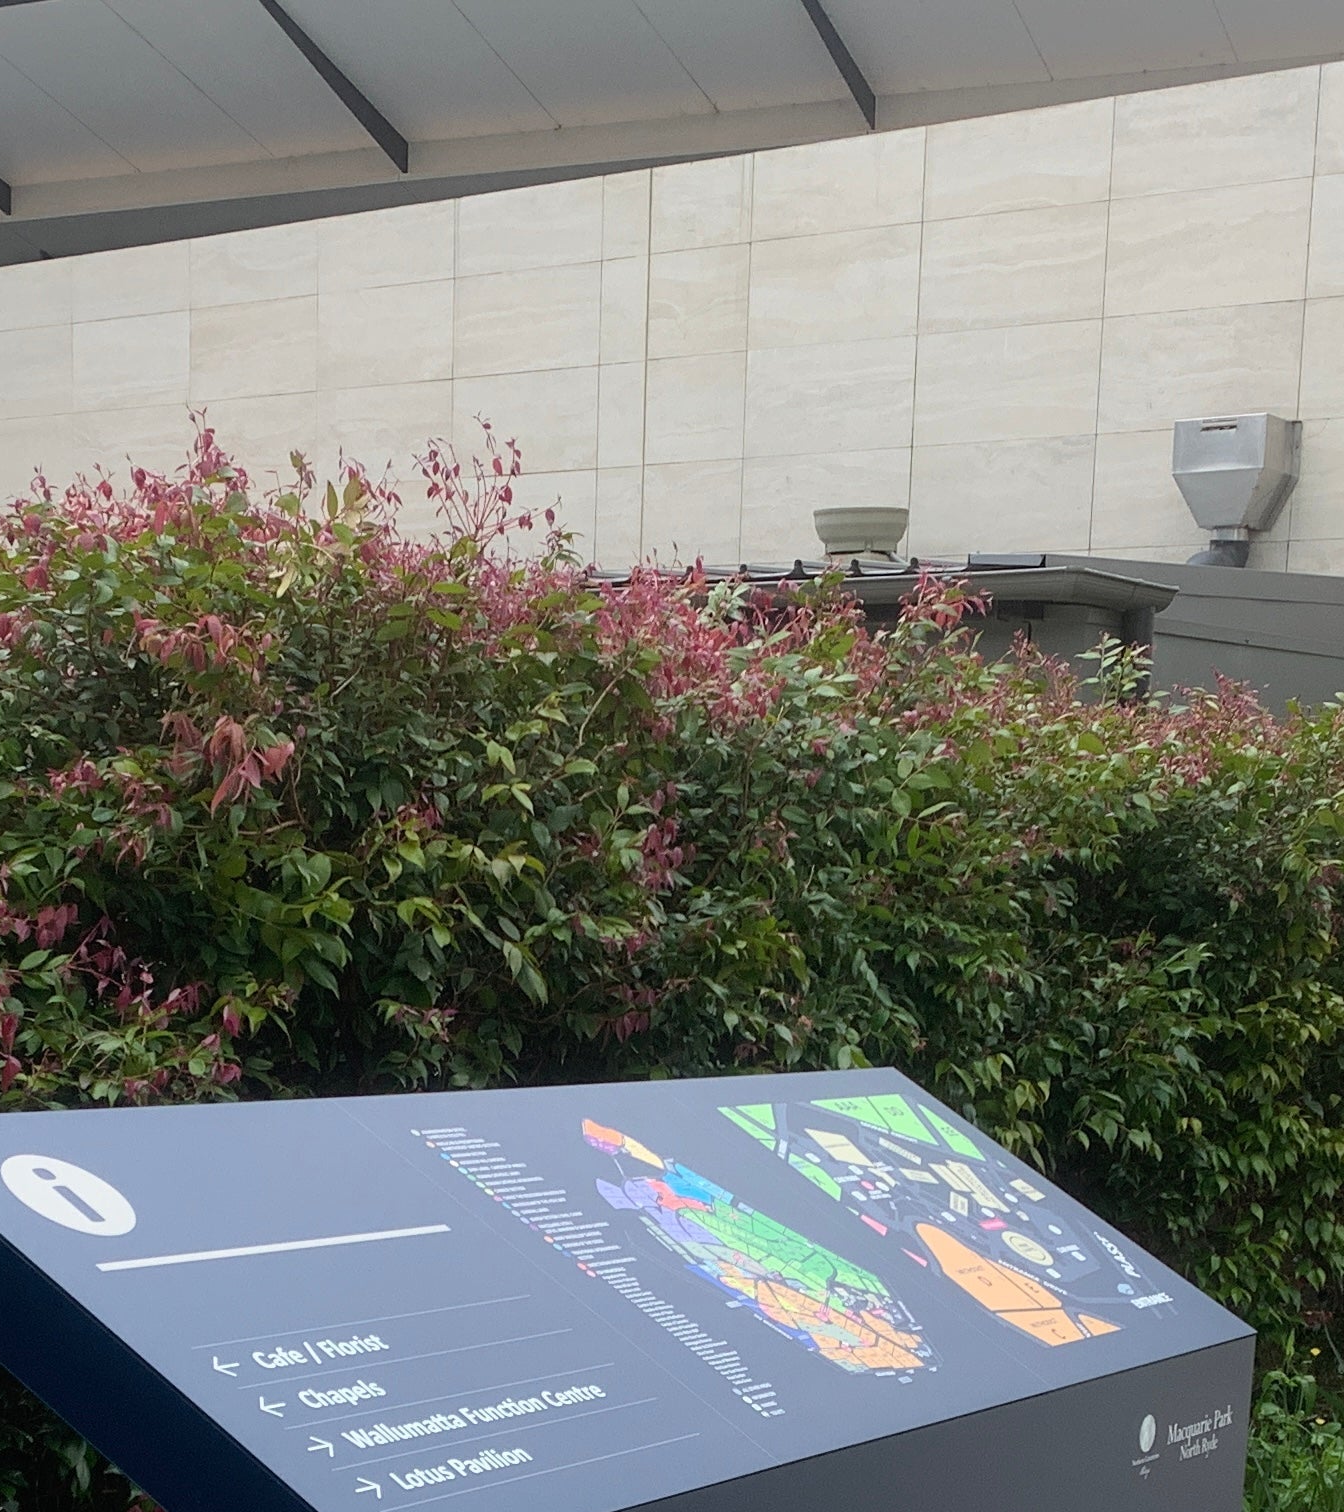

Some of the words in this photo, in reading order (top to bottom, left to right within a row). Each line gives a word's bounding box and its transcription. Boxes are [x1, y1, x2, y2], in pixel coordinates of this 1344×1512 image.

[1130, 1292, 1174, 1310] ENTRANCE
[251, 1339, 304, 1371] Cafe
[321, 1332, 390, 1359] Florist
[297, 1379, 387, 1411] Chapels
[341, 1413, 462, 1450] Wallumatta
[462, 1395, 550, 1427] Function
[541, 1380, 607, 1407] Centre
[1166, 1414, 1213, 1447] Macquarie
[1213, 1404, 1234, 1430] Park
[1179, 1438, 1202, 1461] North
[1201, 1432, 1219, 1460] Ryde
[389, 1462, 454, 1492] Lotus
[452, 1444, 534, 1478] Pavilion
